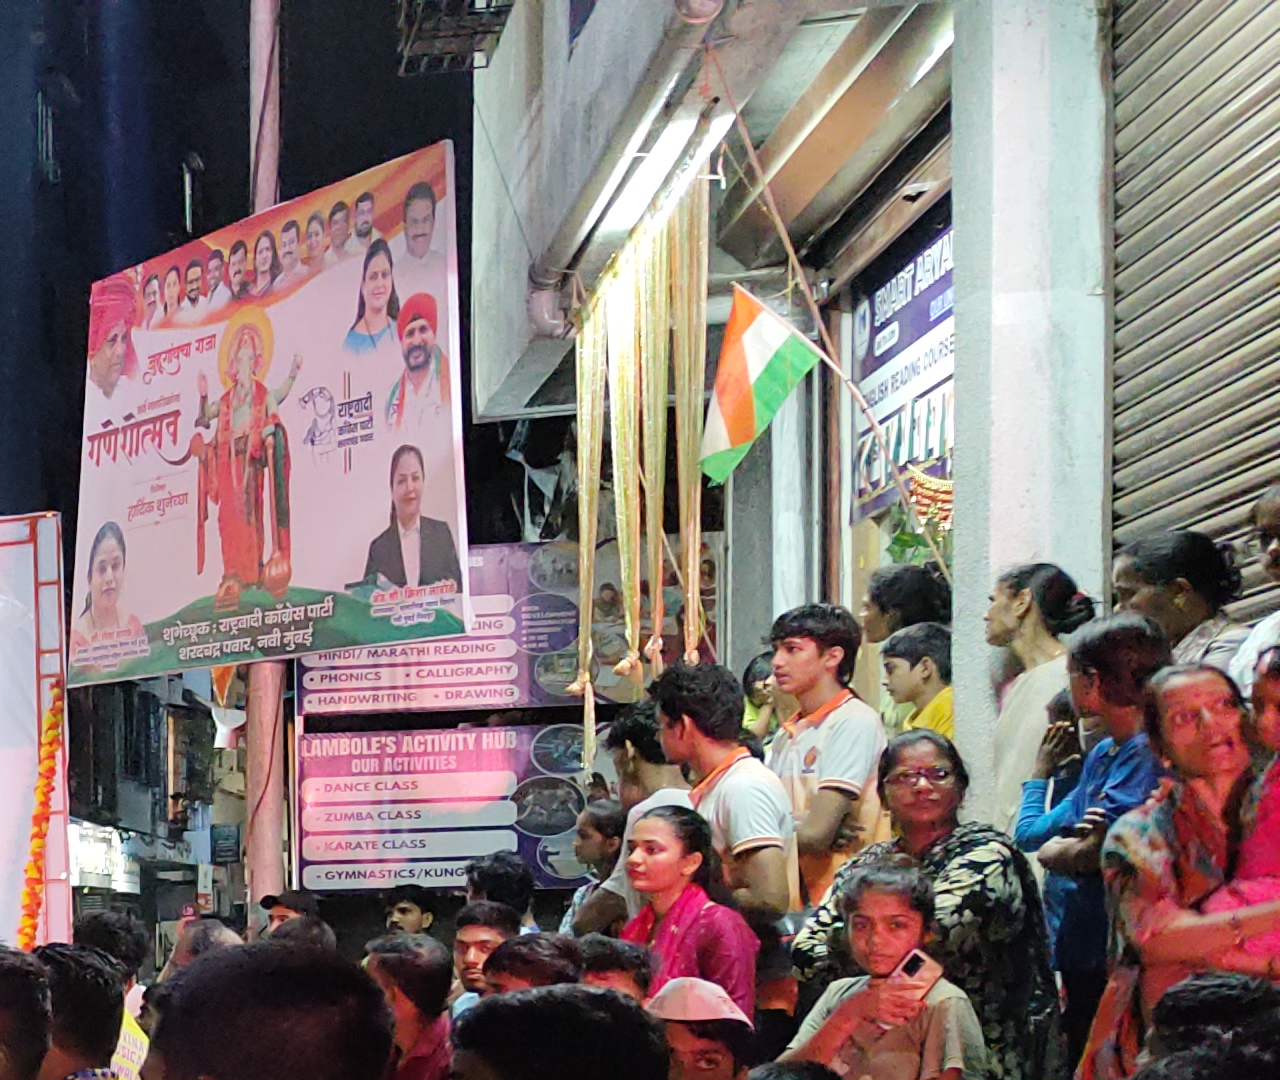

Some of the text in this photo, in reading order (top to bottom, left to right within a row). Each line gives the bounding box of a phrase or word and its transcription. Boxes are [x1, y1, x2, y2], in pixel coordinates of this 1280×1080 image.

[915, 231, 955, 297] ARYA
[890, 356, 922, 397] READING
[306, 594, 335, 618] पार्टी
[178, 636, 222, 662] शरदचंद्र
[257, 627, 281, 649] नवी
[283, 621, 314, 651] मुंबई
[366, 645, 431, 659] MARATHI
[433, 641, 497, 656] READING
[319, 665, 514, 684] PHONICS CALLIGRAPHY
[317, 686, 516, 707] HANDWRITING DRAWING
[300, 730, 517, 758] LAMBOLE'S ACTIVITY HUB
[351, 754, 458, 773] OUR ACTIVITIES
[324, 780, 419, 793] DANCE CLASS
[324, 809, 422, 822] ZUMBA CLASS
[324, 839, 427, 852] KARATE CLASS
